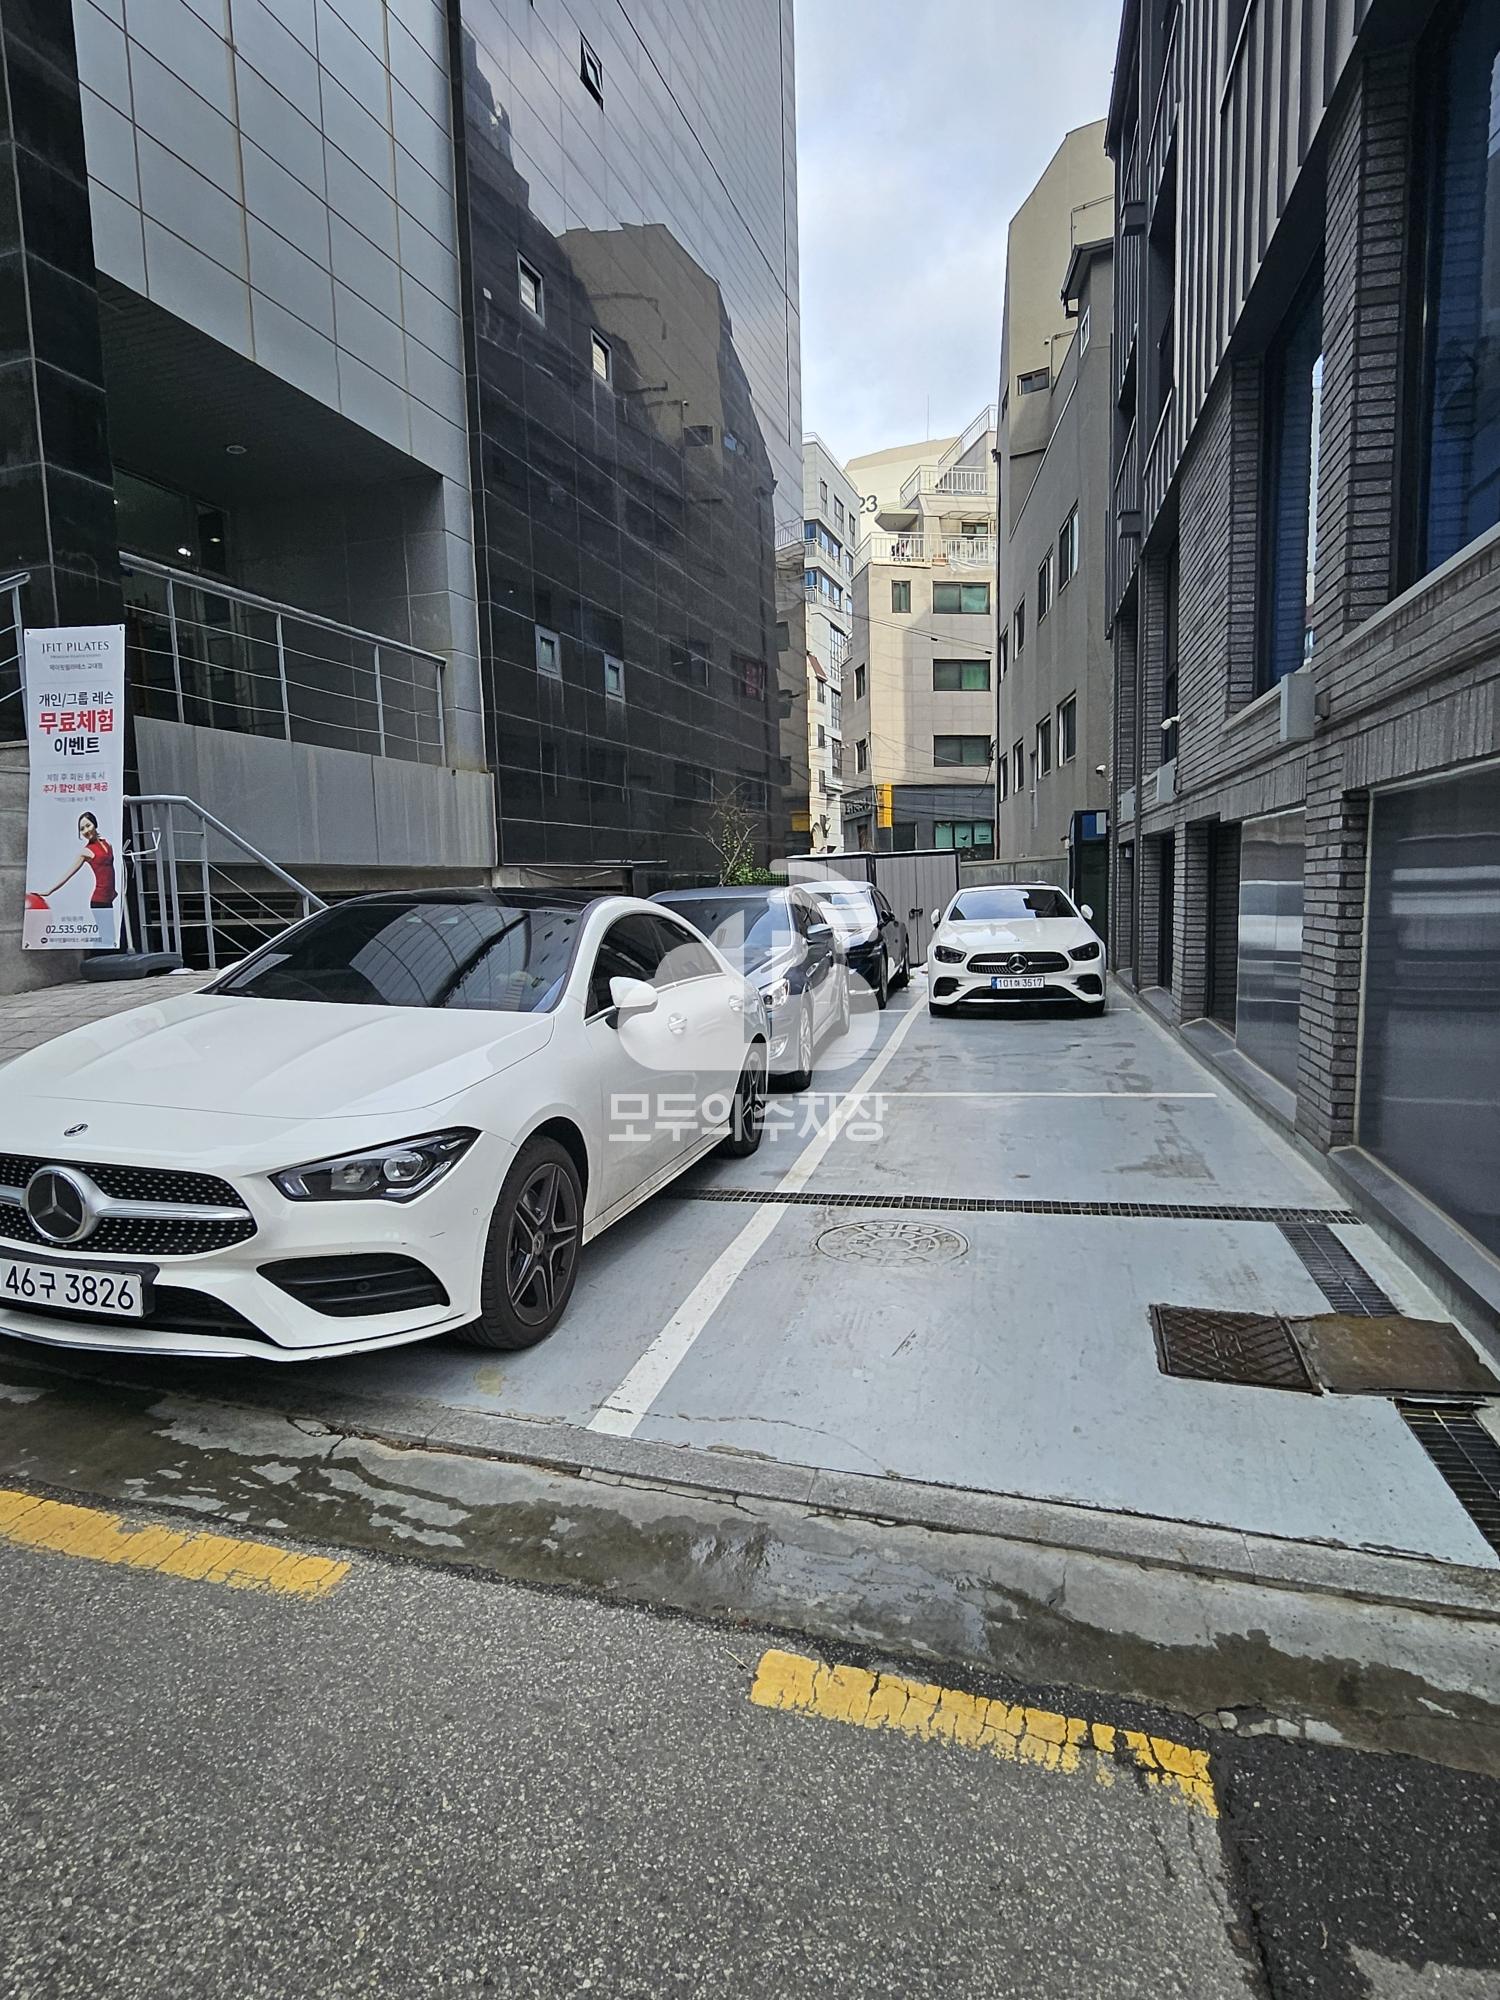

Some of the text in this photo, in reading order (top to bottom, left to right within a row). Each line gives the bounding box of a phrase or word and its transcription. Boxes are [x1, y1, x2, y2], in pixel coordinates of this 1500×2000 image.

[42, 641, 109, 654] JFIT PILATES
[39, 690, 114, 707] 개인/그룹 레슨
[39, 708, 113, 735] 무료체험
[54, 736, 100, 756] 이벤트
[98, 771, 105, 780] 시
[43, 781, 108, 793] 추가 할인 혜택 제공
[46, 924, 98, 934] 02.535.9670
[1022, 978, 1043, 987] 3517
[5, 1265, 134, 1310] 46구 3826
